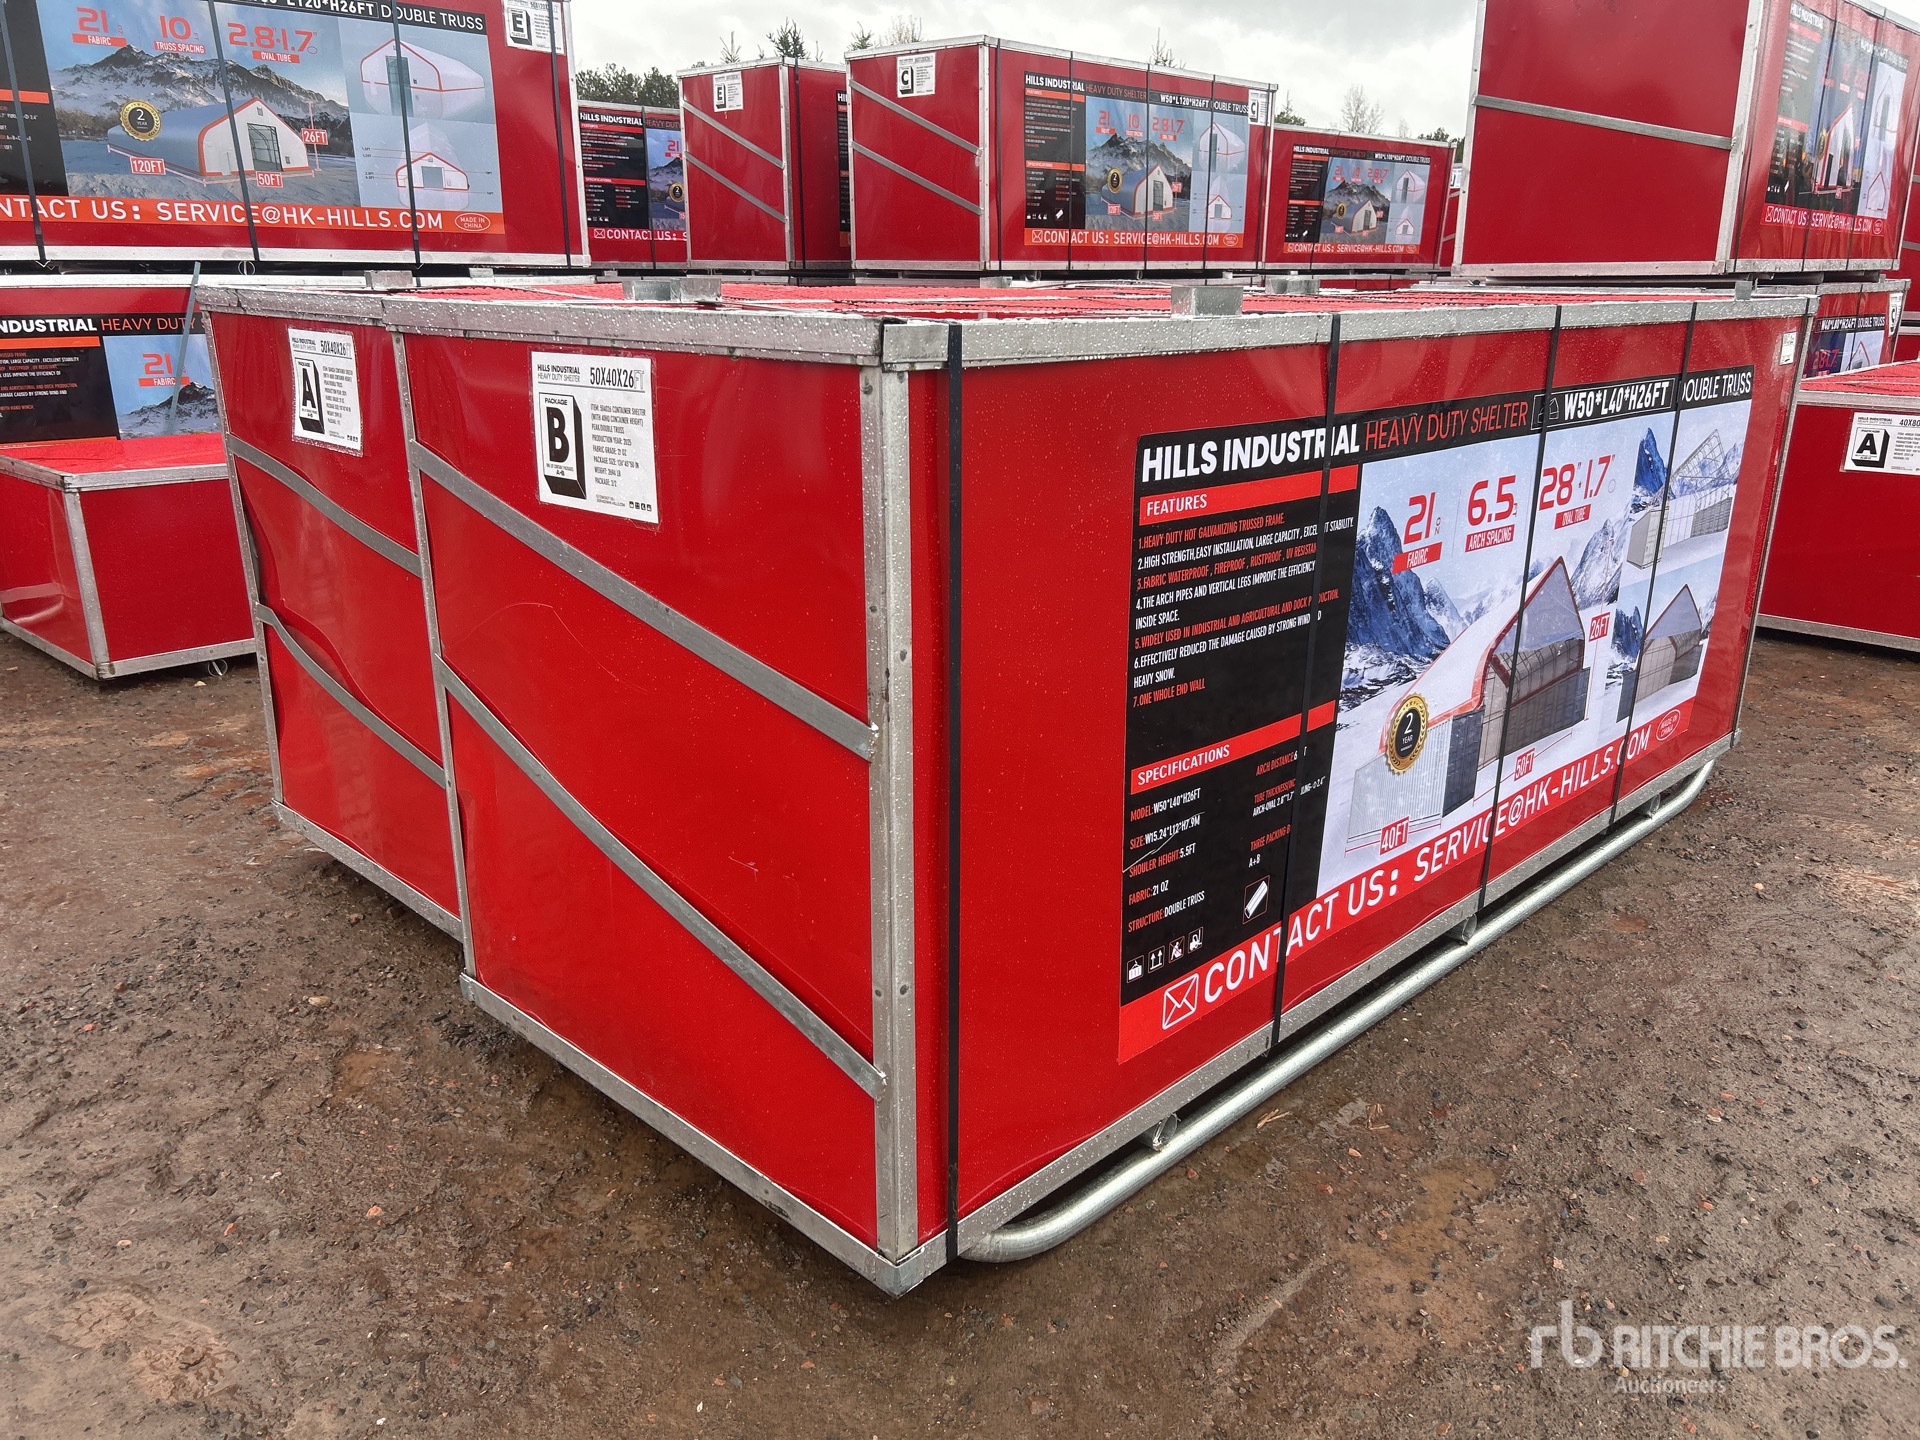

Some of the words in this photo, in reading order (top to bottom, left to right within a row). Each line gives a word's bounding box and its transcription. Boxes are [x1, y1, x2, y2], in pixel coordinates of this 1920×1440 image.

[76, 7, 108, 33] 21
[381, 5, 437, 24] DOUBLE
[441, 13, 484, 30] TRUSS
[512, 13, 524, 33] E
[160, 16, 191, 40] 10
[88, 35, 111, 46] FABIRC
[156, 41, 175, 52] TRUSS
[177, 42, 205, 54] SPACING
[261, 52, 277, 62] OVAL
[278, 53, 292, 62] TUBE
[901, 70, 909, 85] C
[1026, 75, 1044, 85] HILLS
[1045, 78, 1085, 91] INDUSTRIAL
[1085, 84, 1106, 94] HEAVY
[1107, 87, 1122, 97] DUTY
[1124, 90, 1147, 100] SHELTER
[717, 87, 722, 100] E
[137, 109, 145, 120] 2
[1251, 101, 1256, 114] C
[580, 113, 600, 121] HILLS
[601, 114, 643, 125] INDUSTRIAL
[1099, 110, 1110, 125] 21
[1129, 113, 1140, 128] 10
[304, 130, 326, 143] 26FT
[668, 140, 679, 151] 21
[1305, 146, 1329, 154] INDUSTRIAL
[1419, 156, 1430, 164] TRUSS
[132, 159, 164, 174] 120FT
[258, 173, 281, 185] 50FT
[91, 200, 140, 220] US:
[157, 201, 443, 230] SERVICE@HK-HILLS.COM
[1773, 208, 1797, 224] CONTACT
[607, 230, 652, 239] CONTACT
[1044, 231, 1089, 243] CONTACT
[1337, 244, 1404, 253] SERVICE@HK-HILLS.COM
[101, 318, 151, 331] HEAVY
[157, 318, 196, 330] DUTY
[1873, 317, 1885, 327] TRUSS
[142, 353, 173, 374] 21
[538, 364, 550, 372] HILLS
[551, 365, 580, 374] INDUSTRIAL
[564, 374, 580, 382] SHELTER
[302, 368, 316, 409] A
[546, 406, 570, 463] B
[1141, 440, 1218, 483] HILLS
[1365, 415, 1424, 451] HEAVY
[1427, 409, 1470, 442] DUTY
[1470, 401, 1528, 434] SHELTER
[1722, 371, 1752, 397] TRUSS
[592, 434, 612, 443] PRODUCTION
[1856, 433, 1877, 454] A
[1147, 493, 1208, 516] FEATURES
[1467, 474, 1516, 527] 6.5
[1403, 492, 1436, 545] 21
[1562, 511, 1573, 526] OVAL
[1574, 507, 1586, 522] TUBE
[1138, 531, 1164, 549] 1.HEAVY
[1165, 529, 1183, 543] DUTY
[1184, 528, 1196, 542] HOT
[1198, 520, 1238, 538] GALVANIZING
[1239, 516, 1264, 534] TRUSSED
[1265, 512, 1285, 529] FRAME.
[1468, 532, 1485, 551] ARCH
[1486, 526, 1513, 547] SPACING
[1137, 553, 1160, 570] 2.HIGH
[1213, 537, 1254, 557] INSTALLATION,
[1255, 534, 1273, 548] LARGE
[1406, 548, 1429, 569] FABIRC
[1136, 572, 1167, 591] 3.FABRIC
[1168, 566, 1210, 583] WATERPROOF
[1214, 558, 1246, 575] FIREPROOF
[1250, 550, 1281, 568] RUSTPROOF
[1286, 548, 1293, 560] UV
[1136, 593, 1155, 610] 4.THE
[1156, 589, 1174, 606] ARCH
[1176, 587, 1193, 604] PIPES
[1194, 584, 1207, 599] AND
[1209, 577, 1236, 596] VERTICAL
[1238, 575, 1251, 590] LEGS
[1252, 569, 1276, 586] IMPROVE
[1278, 567, 1287, 580] THE
[1288, 560, 1316, 578] EFFICIENCY
[1135, 612, 1157, 630] INSIDE
[1158, 609, 1180, 625] SPACE.
[1135, 631, 1163, 650] 5.WIDELY
[1166, 629, 1181, 643] USED
[1183, 627, 1190, 639] IN
[1192, 616, 1227, 636] INDUSTRIAL
[1228, 614, 1240, 628] AND
[1241, 605, 1280, 624] AGRICULTURAL
[1281, 602, 1292, 614] AND
[1293, 599, 1308, 612] DOCK
[1590, 614, 1609, 640] 26FT
[1134, 647, 1178, 669] 6.EFFECTIVELY
[1180, 641, 1207, 658] REDUCED
[1208, 638, 1220, 651] THE
[1221, 632, 1245, 648] DAMAGE
[1246, 625, 1267, 641] CAUSED
[1268, 622, 1275, 635] BY
[1276, 616, 1297, 633] STRONG
[1298, 612, 1311, 627] WIND
[1133, 672, 1154, 688] HEAVY
[1155, 667, 1176, 683] SNOW.
[1133, 691, 1152, 708] 7.ONE
[1153, 685, 1175, 702] WHOLE
[1176, 683, 1188, 696] END
[1189, 678, 1206, 693] WALL
[1404, 712, 1413, 734] 2
[1402, 735, 1413, 744] YEAR
[1137, 744, 1230, 786] SPECIFICATIONS
[1256, 760, 1271, 776] ARCH
[1515, 751, 1535, 778] 50FT
[1254, 791, 1265, 804] TUBE
[1250, 838, 1265, 852] THREE
[1266, 829, 1286, 845] PACKING
[1381, 818, 1410, 852] 40FT
[1129, 858, 1156, 878] SHOULER
[1248, 854, 1261, 868] A+B
[1160, 880, 1169, 893] OZ
[1187, 891, 1205, 906] TRUSS
[1204, 891, 1339, 1003] CONTACT
[1348, 868, 1398, 916] US:
